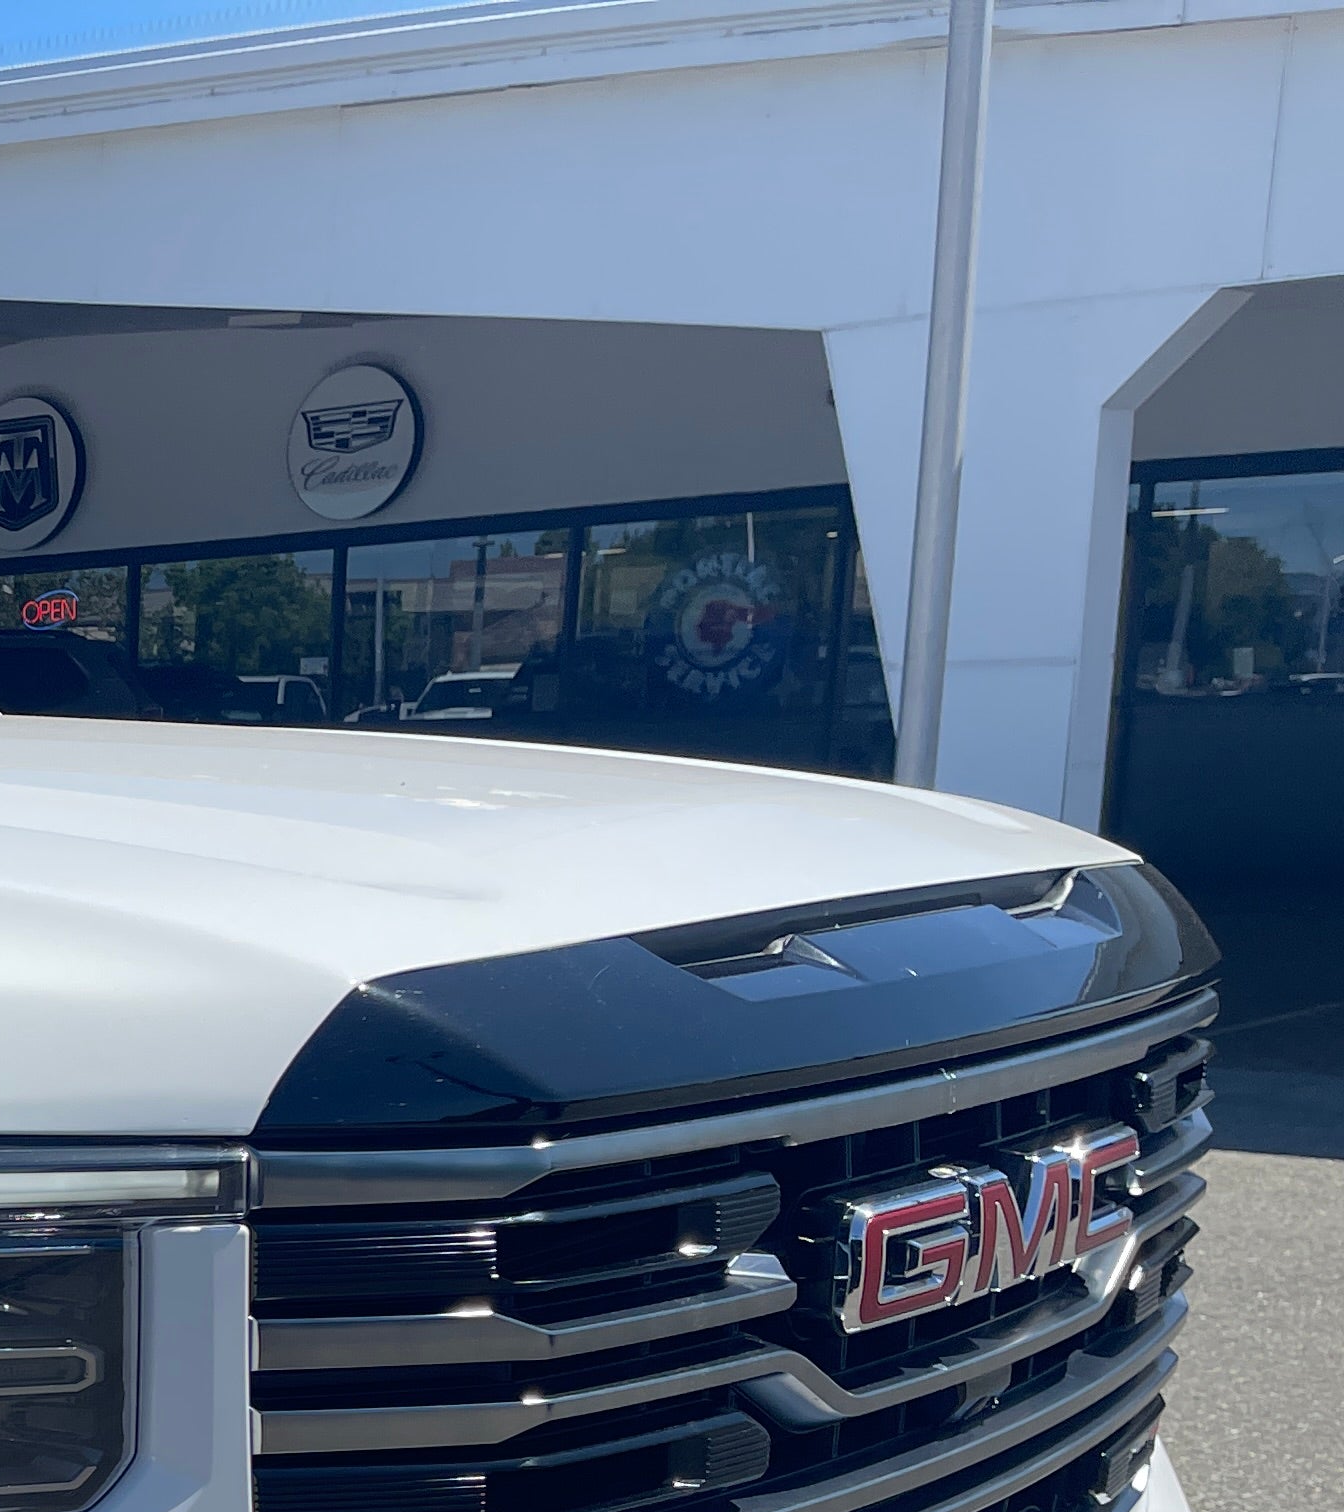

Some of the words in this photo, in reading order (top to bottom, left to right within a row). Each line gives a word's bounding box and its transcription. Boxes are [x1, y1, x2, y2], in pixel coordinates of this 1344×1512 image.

[301, 455, 398, 491] Cadillac
[22, 598, 77, 624] OPEN
[842, 1125, 1140, 1334] GMC
